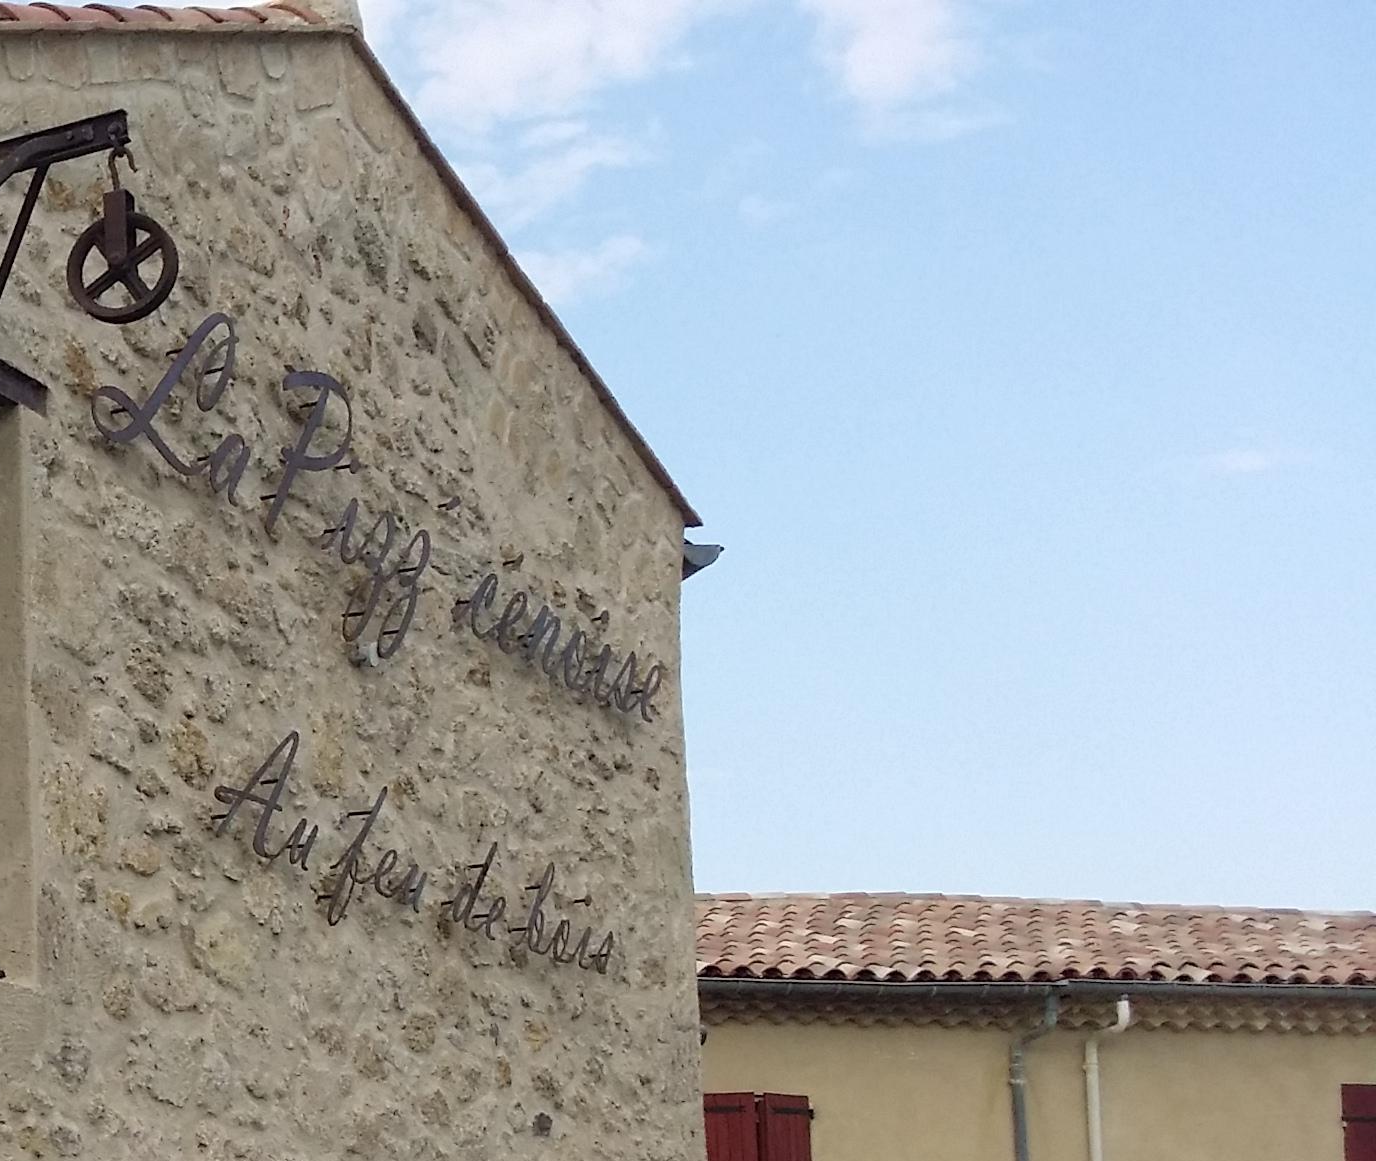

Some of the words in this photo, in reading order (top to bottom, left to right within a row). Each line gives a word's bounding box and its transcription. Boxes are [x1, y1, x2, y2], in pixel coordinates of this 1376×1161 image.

[91, 312, 250, 506] La
[213, 730, 319, 871] Au
[328, 785, 428, 927] feu
[451, 841, 507, 941] de
[515, 861, 614, 975] bois
